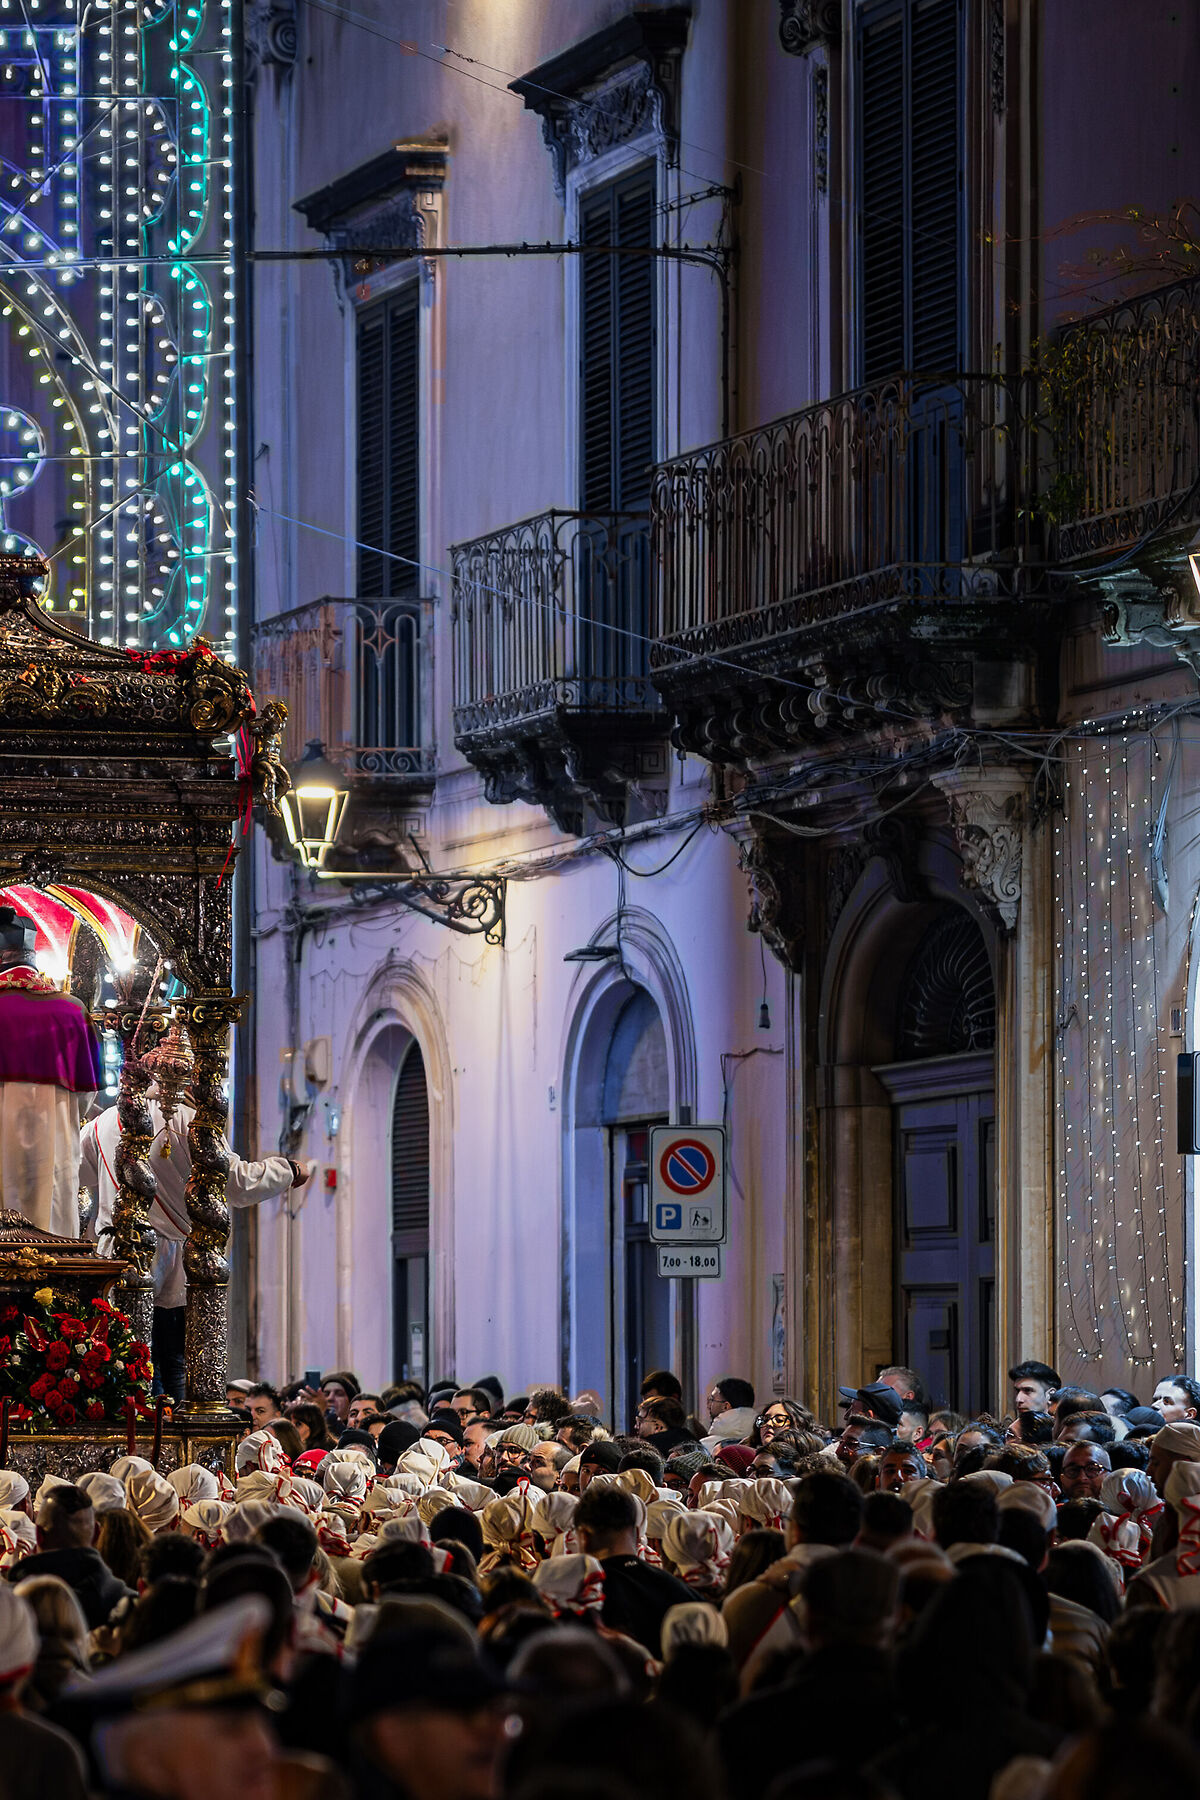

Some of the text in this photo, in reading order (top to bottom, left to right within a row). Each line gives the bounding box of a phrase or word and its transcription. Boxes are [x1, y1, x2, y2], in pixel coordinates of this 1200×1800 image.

[661, 1207, 677, 1227] P
[662, 1256, 681, 1268] 7.00
[689, 1255, 716, 1268] 18.00
